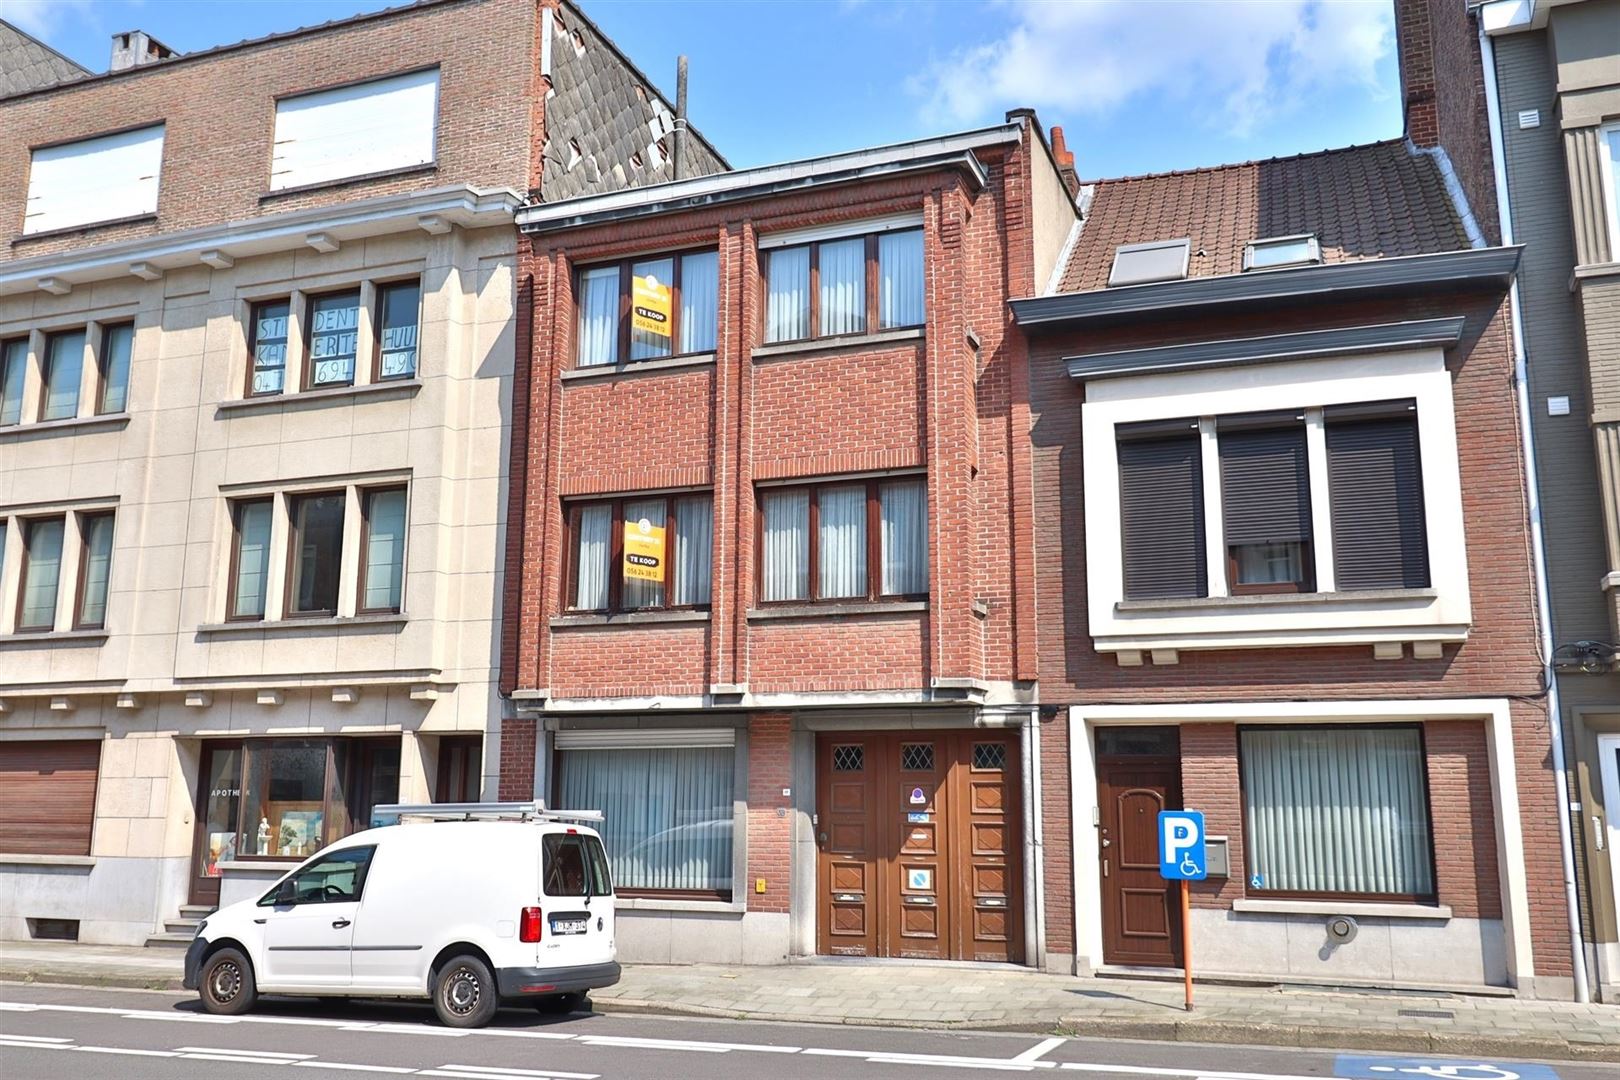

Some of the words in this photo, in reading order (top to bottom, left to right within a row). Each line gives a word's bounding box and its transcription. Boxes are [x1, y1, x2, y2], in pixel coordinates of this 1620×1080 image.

[638, 308, 646, 316] TE
[648, 311, 664, 320] KOOP
[630, 555, 638, 563] TE
[639, 557, 656, 565] KOOP
[1164, 817, 1199, 864] P
